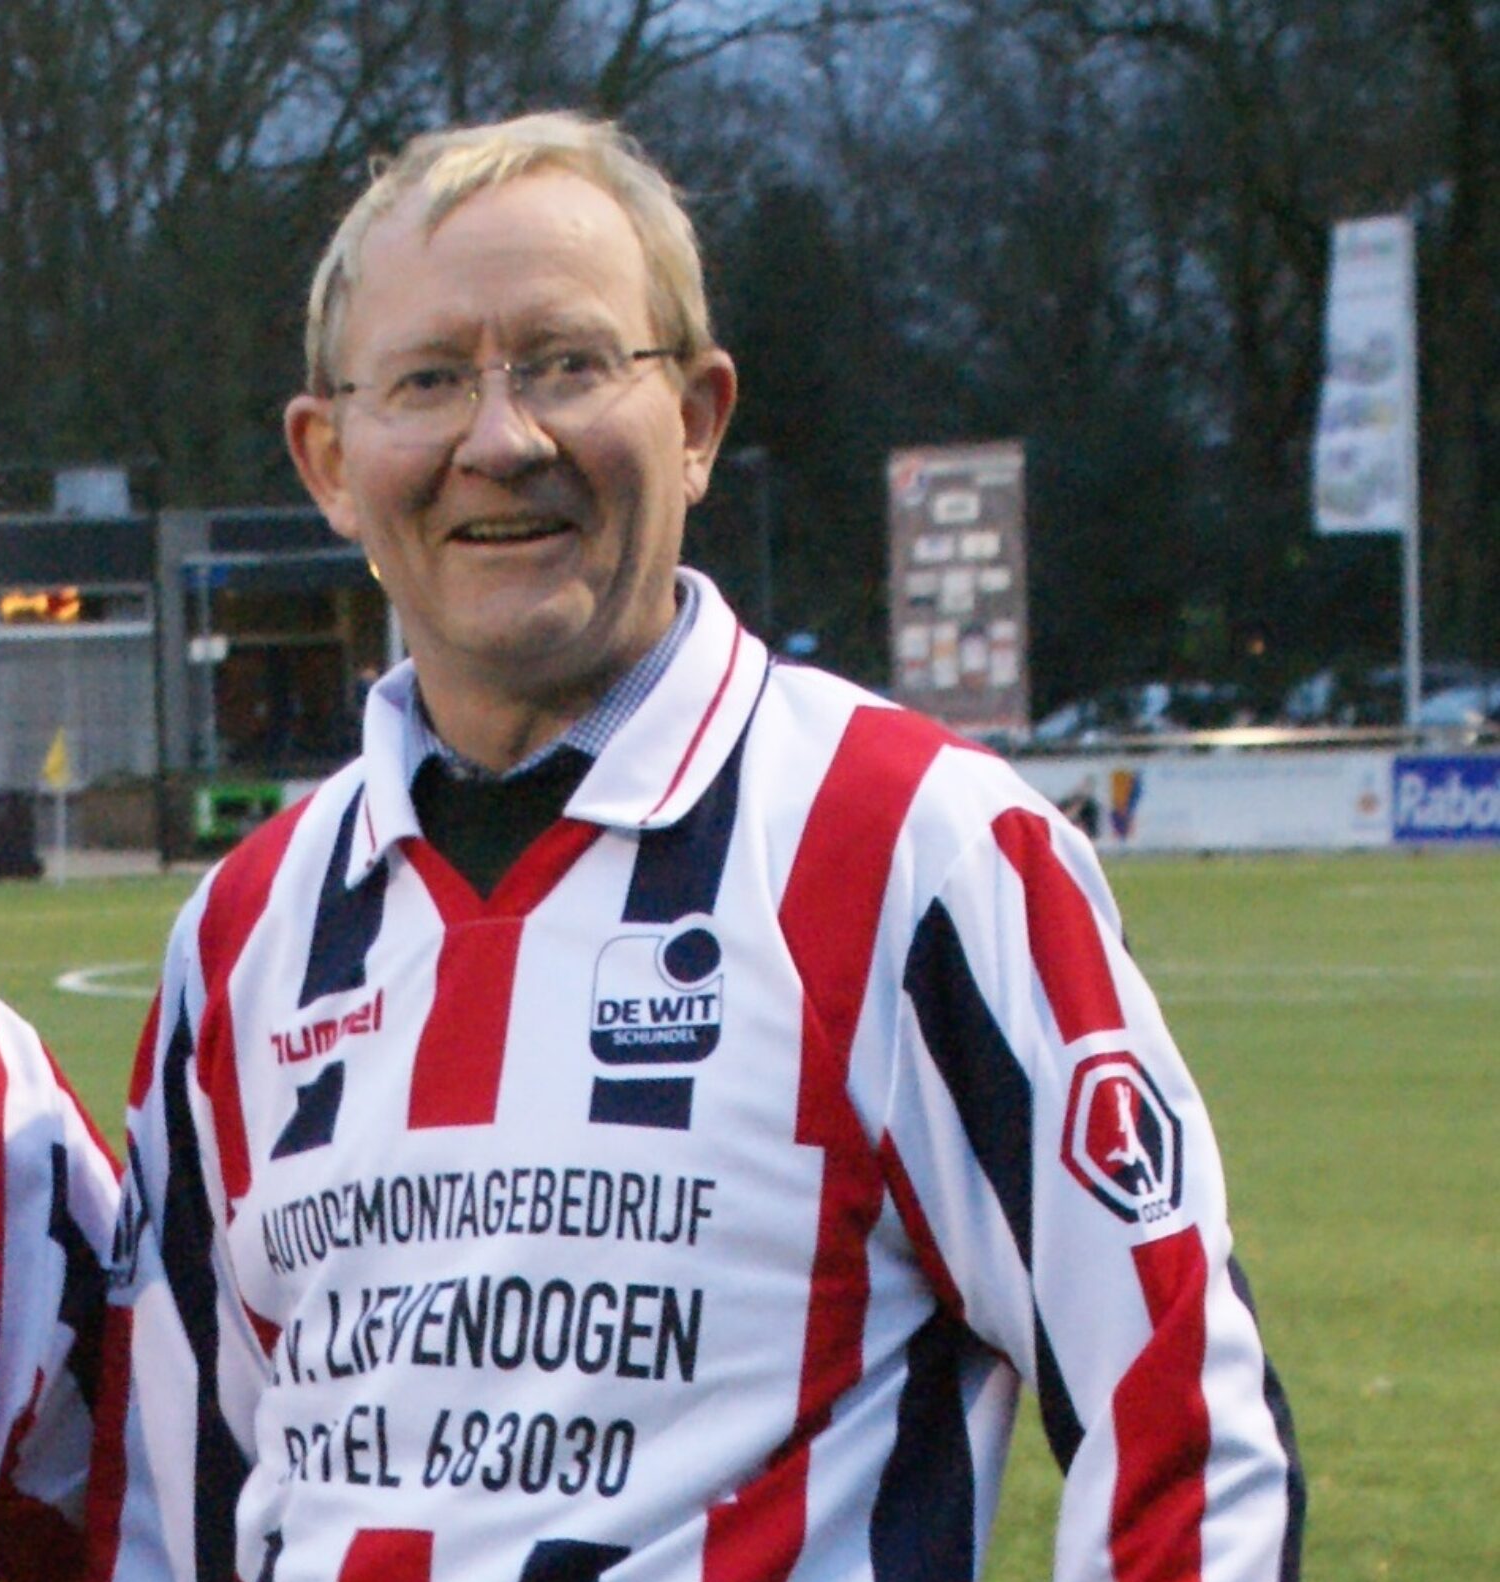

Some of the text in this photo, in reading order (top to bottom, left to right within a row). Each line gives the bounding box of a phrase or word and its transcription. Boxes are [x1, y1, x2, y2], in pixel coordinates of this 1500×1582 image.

[1399, 772, 1500, 828] Rabo
[596, 993, 717, 1026] DE WIT
[422, 1408, 636, 1498] 683030
